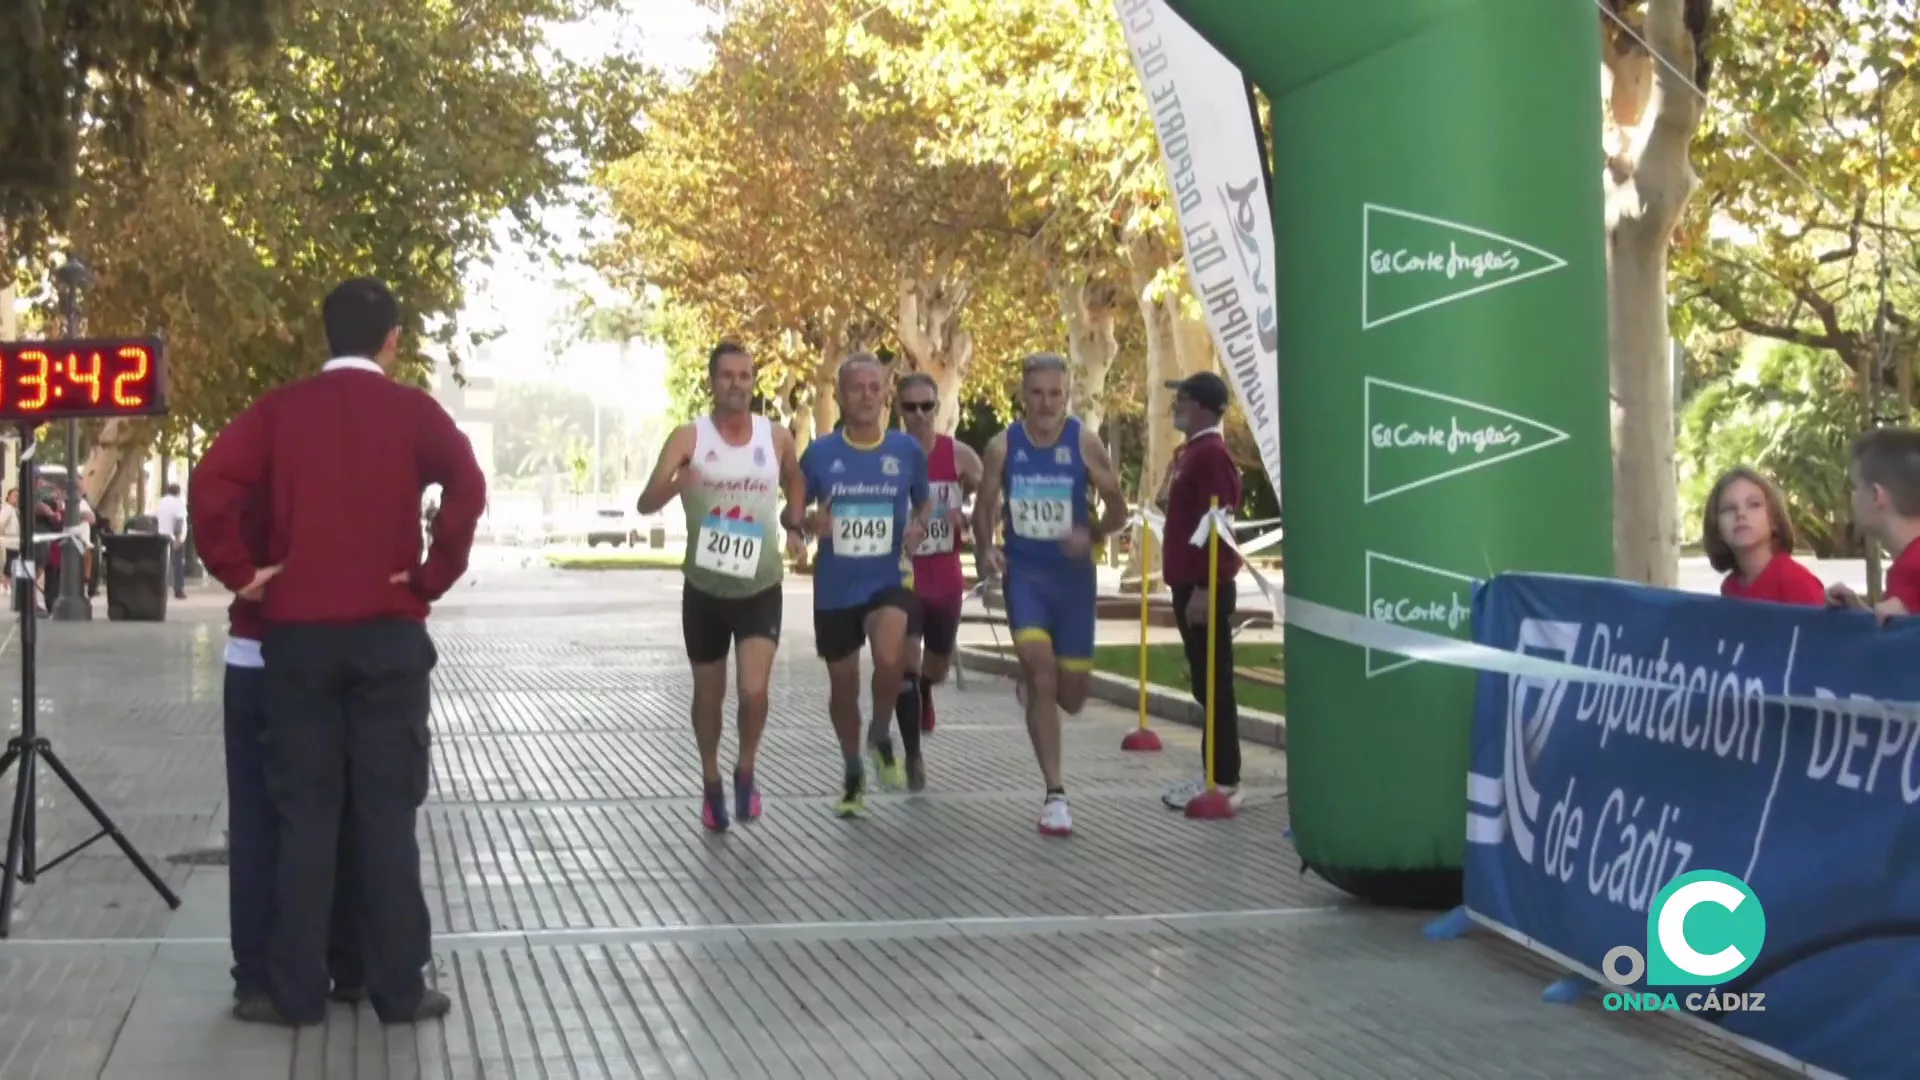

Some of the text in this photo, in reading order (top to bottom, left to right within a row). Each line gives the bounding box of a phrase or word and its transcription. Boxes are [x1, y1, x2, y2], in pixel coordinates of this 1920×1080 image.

[1370, 240, 1520, 280] El Corte Inglés
[0, 348, 147, 409] 3:42
[1371, 416, 1521, 454] El Corte Inglés
[707, 530, 755, 561] 2010
[840, 519, 887, 540] 2049
[1373, 598, 1394, 622] El
[1395, 598, 1446, 622] Corte
[1576, 622, 1765, 764] Diputación
[1544, 776, 1584, 883] de
